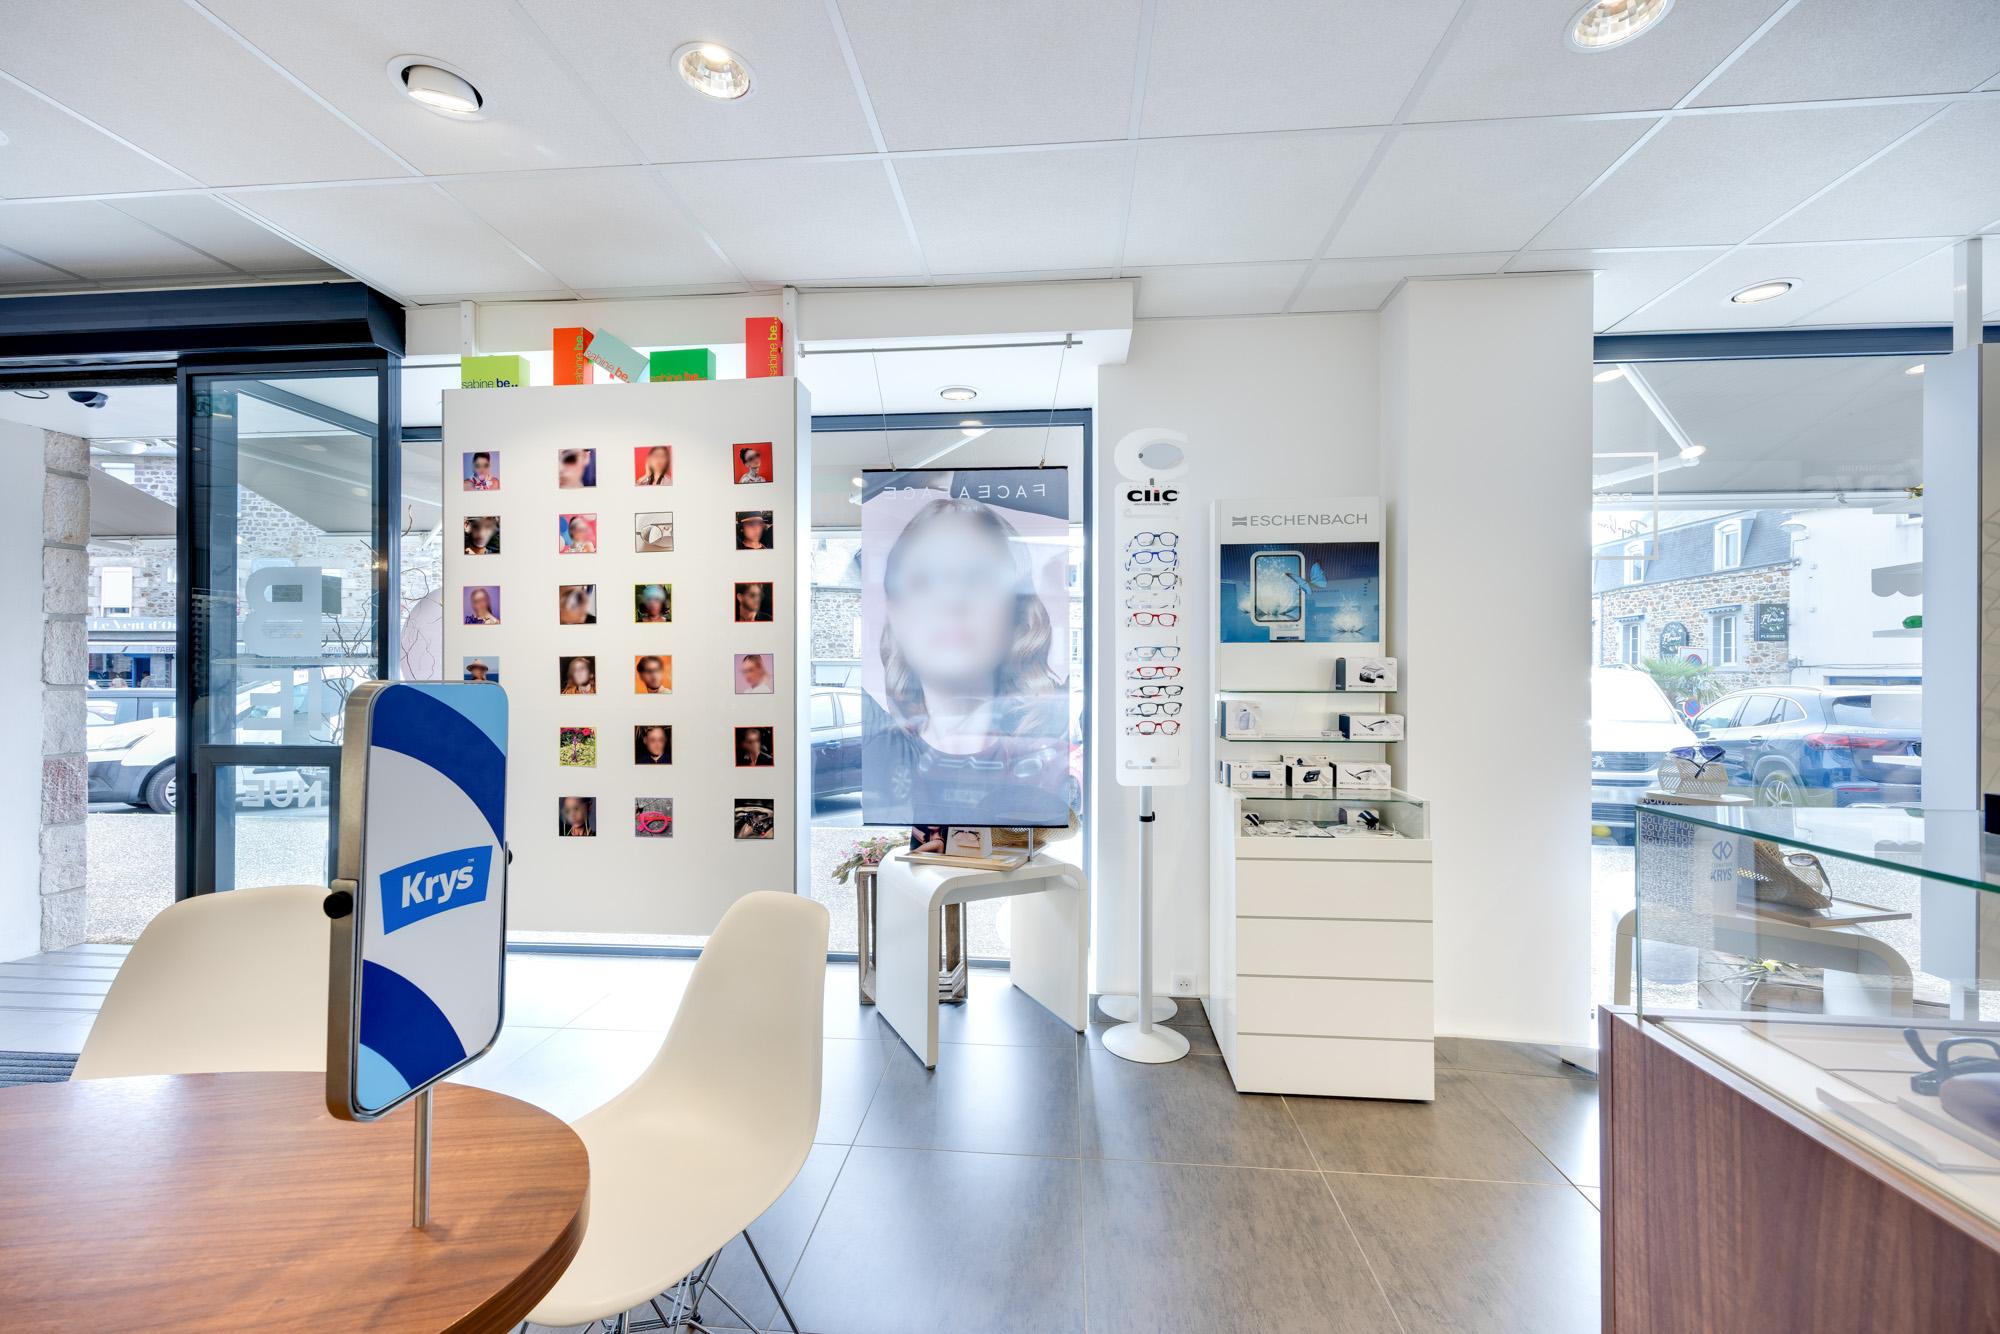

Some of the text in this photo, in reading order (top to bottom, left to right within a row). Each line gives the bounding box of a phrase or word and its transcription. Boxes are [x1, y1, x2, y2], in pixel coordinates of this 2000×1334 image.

[767, 343, 778, 377] sabine
[461, 379, 494, 389] sabine
[1250, 513, 1368, 527] ESCHENBACH
[402, 866, 473, 908] Krys
